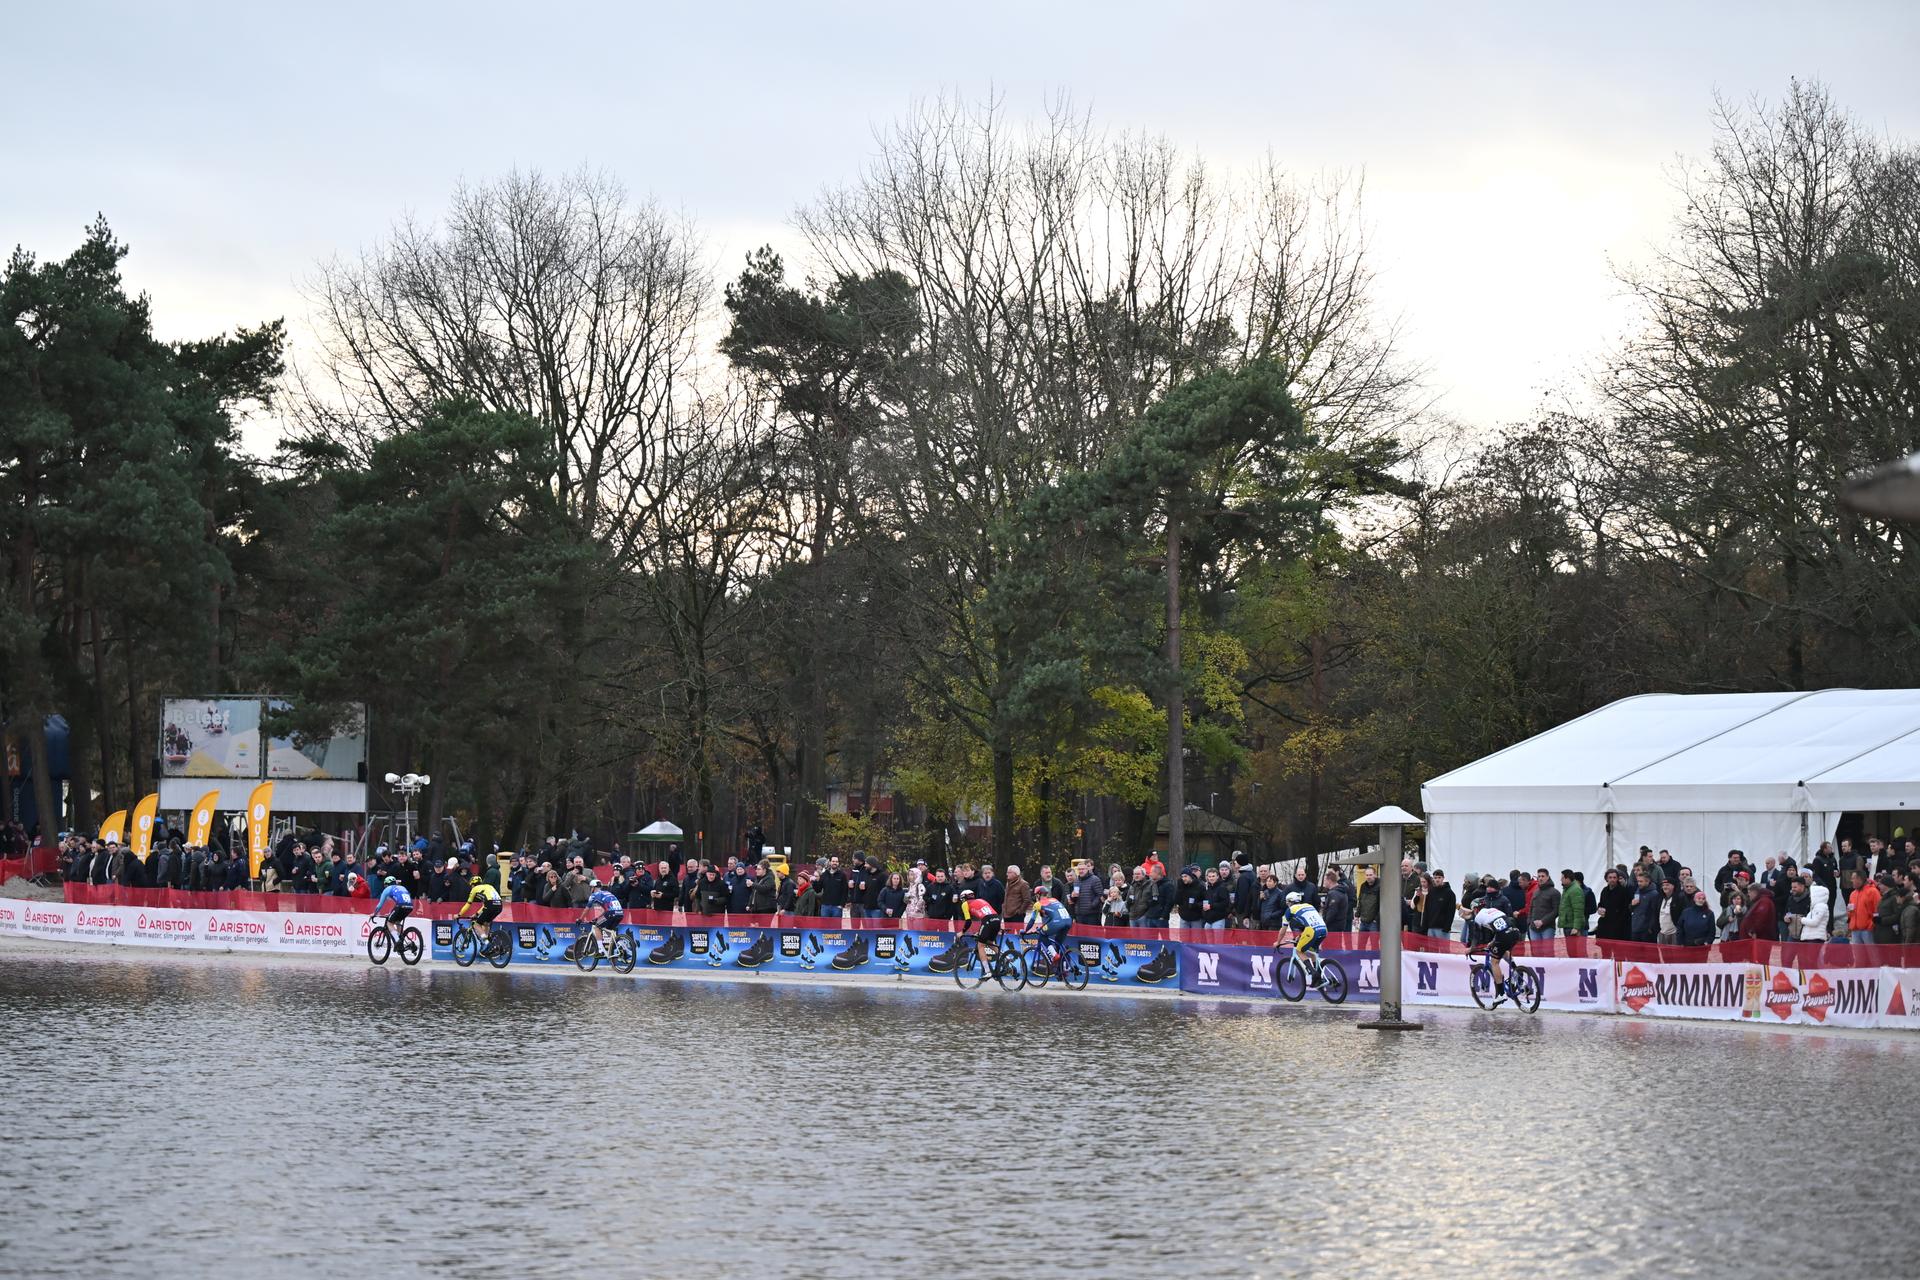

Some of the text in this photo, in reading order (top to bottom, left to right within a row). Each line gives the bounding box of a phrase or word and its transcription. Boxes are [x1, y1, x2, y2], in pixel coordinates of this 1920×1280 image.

[174, 709, 230, 725] Beleef
[0, 910, 14, 920] STON
[31, 913, 64, 924] ARISTON
[86, 917, 121, 928] ARISTON
[149, 920, 192, 931] ARISTON
[219, 922, 265, 934] ARISTON
[296, 925, 342, 937] ARISTON
[1198, 952, 1219, 980] N
[1251, 955, 1273, 983] N
[1358, 959, 1380, 987] N
[1418, 962, 1439, 990] N
[1578, 968, 1597, 997] N
[1621, 982, 1655, 998] Pauwels
[1767, 991, 1799, 1004] Pauwels
[1803, 994, 1834, 1008] Pauwels
